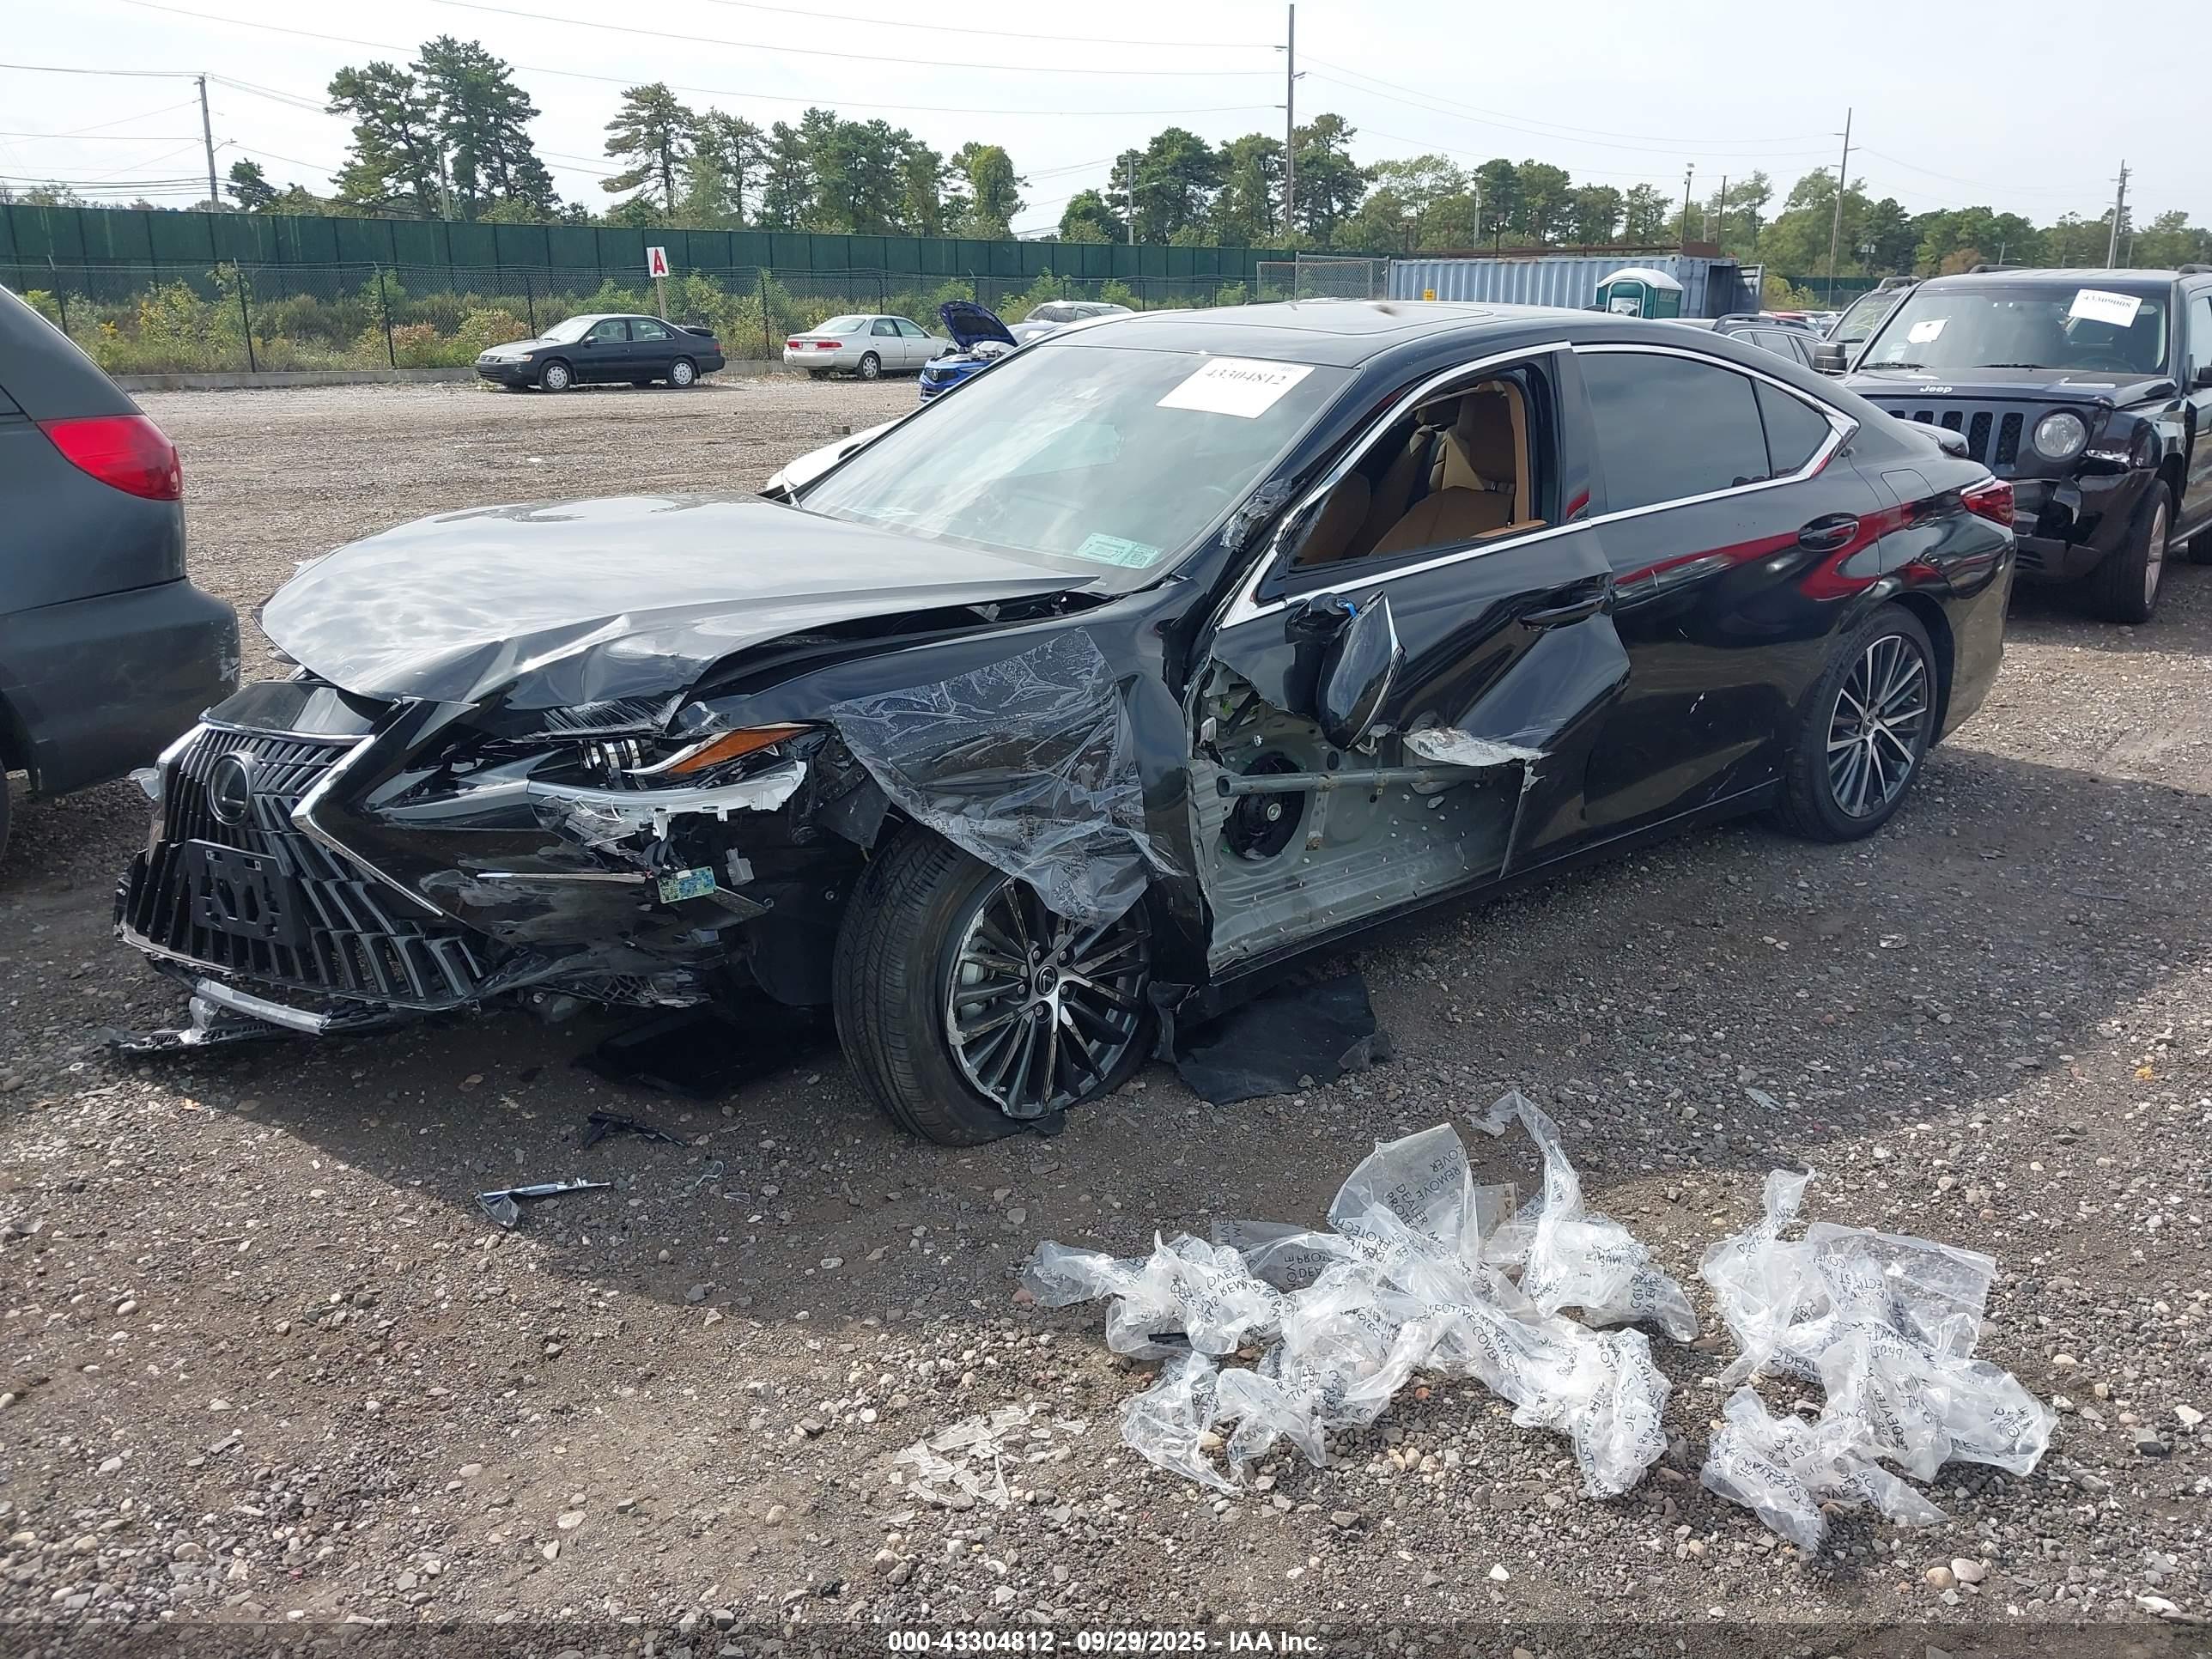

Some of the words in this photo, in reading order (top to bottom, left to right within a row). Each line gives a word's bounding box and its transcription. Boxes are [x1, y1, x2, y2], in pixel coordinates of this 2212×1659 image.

[653, 248, 665, 274] A
[1206, 368, 1287, 386] 43304812
[1919, 385, 1954, 394] Jeep
[1430, 1144, 1465, 1173] COVER
[1416, 1164, 1462, 1200] REMOVE
[1395, 1183, 1429, 1226] DEALER
[1472, 1326, 1500, 1363] COVER
